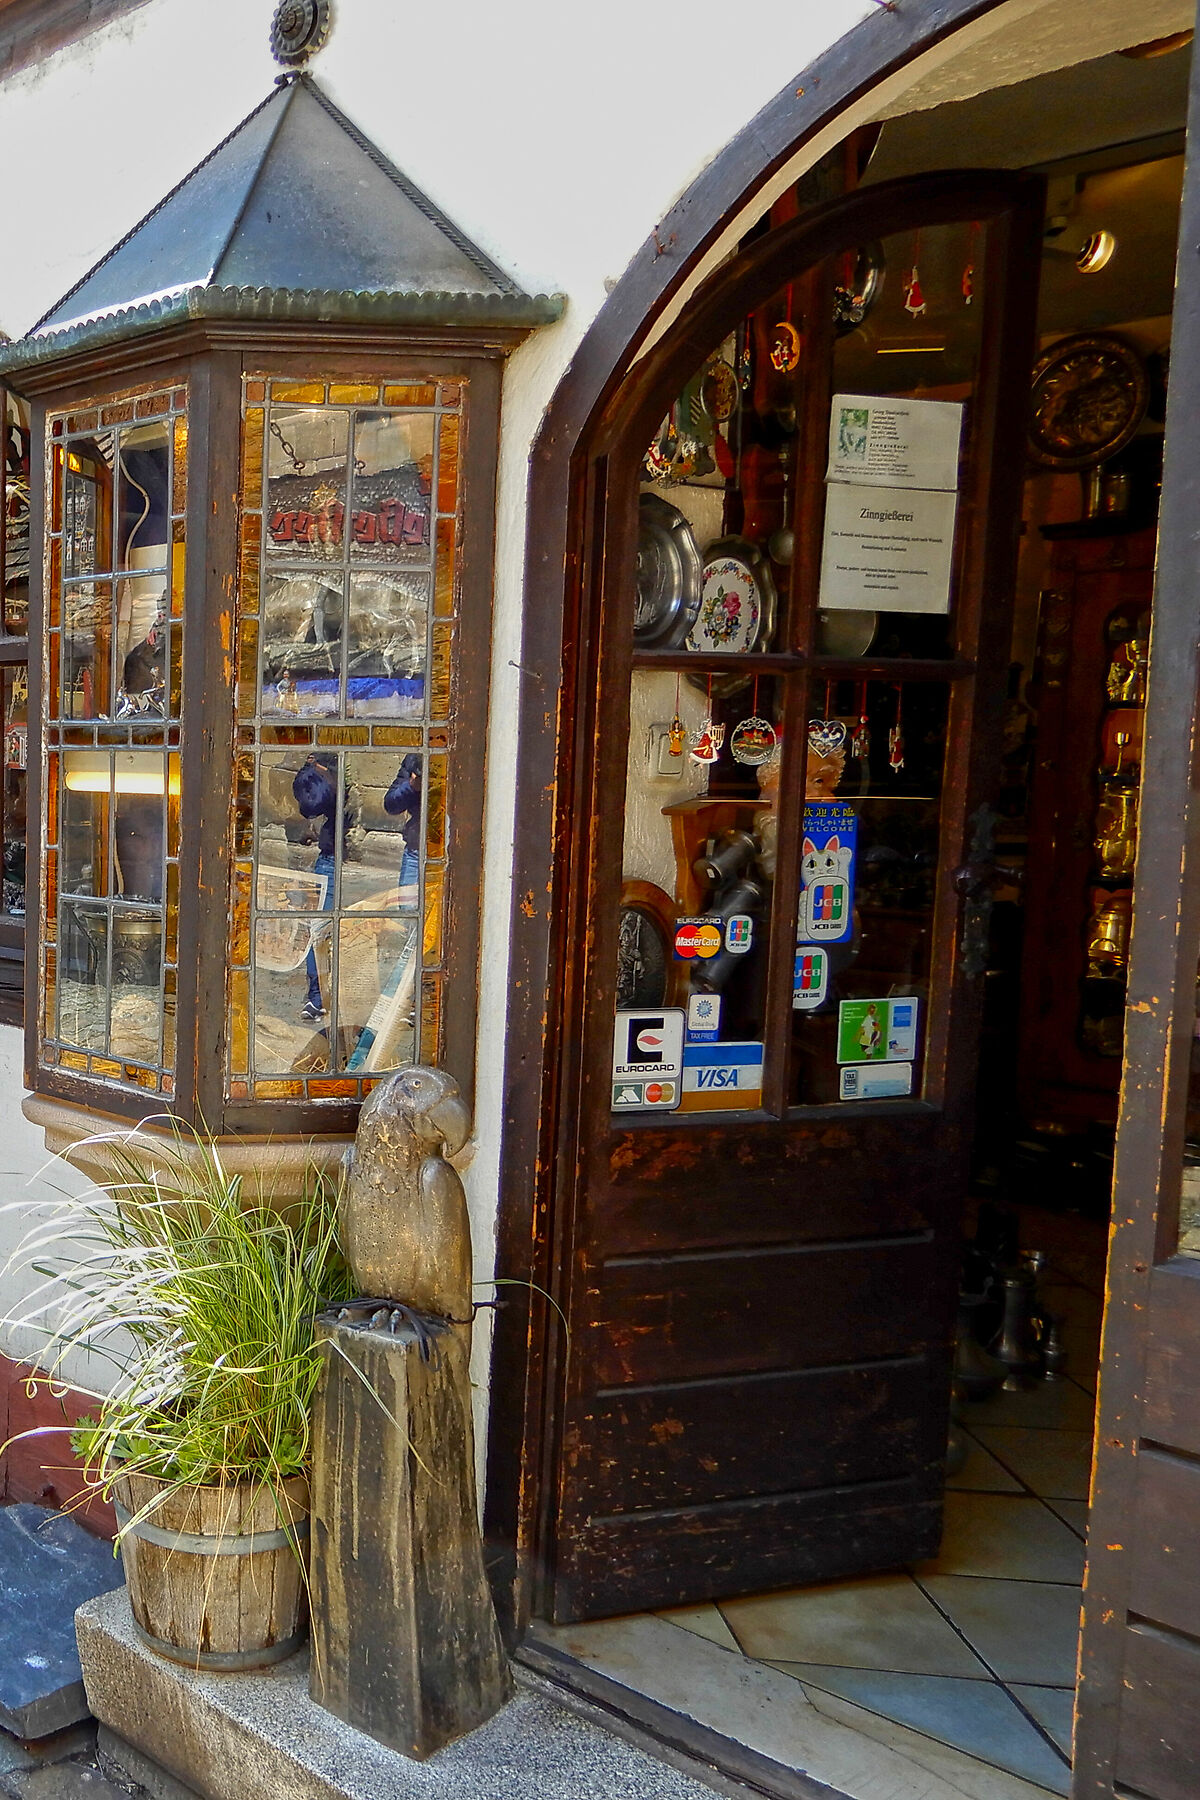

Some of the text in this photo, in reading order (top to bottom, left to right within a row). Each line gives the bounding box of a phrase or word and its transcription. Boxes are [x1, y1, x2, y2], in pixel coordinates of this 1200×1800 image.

[860, 508, 914, 522] Zinngießerei
[813, 898, 842, 907] JCB
[675, 936, 720, 946] MasterCard
[793, 968, 821, 977] JCB
[615, 1064, 675, 1073] EUROCARD
[696, 1069, 738, 1088] VISA
